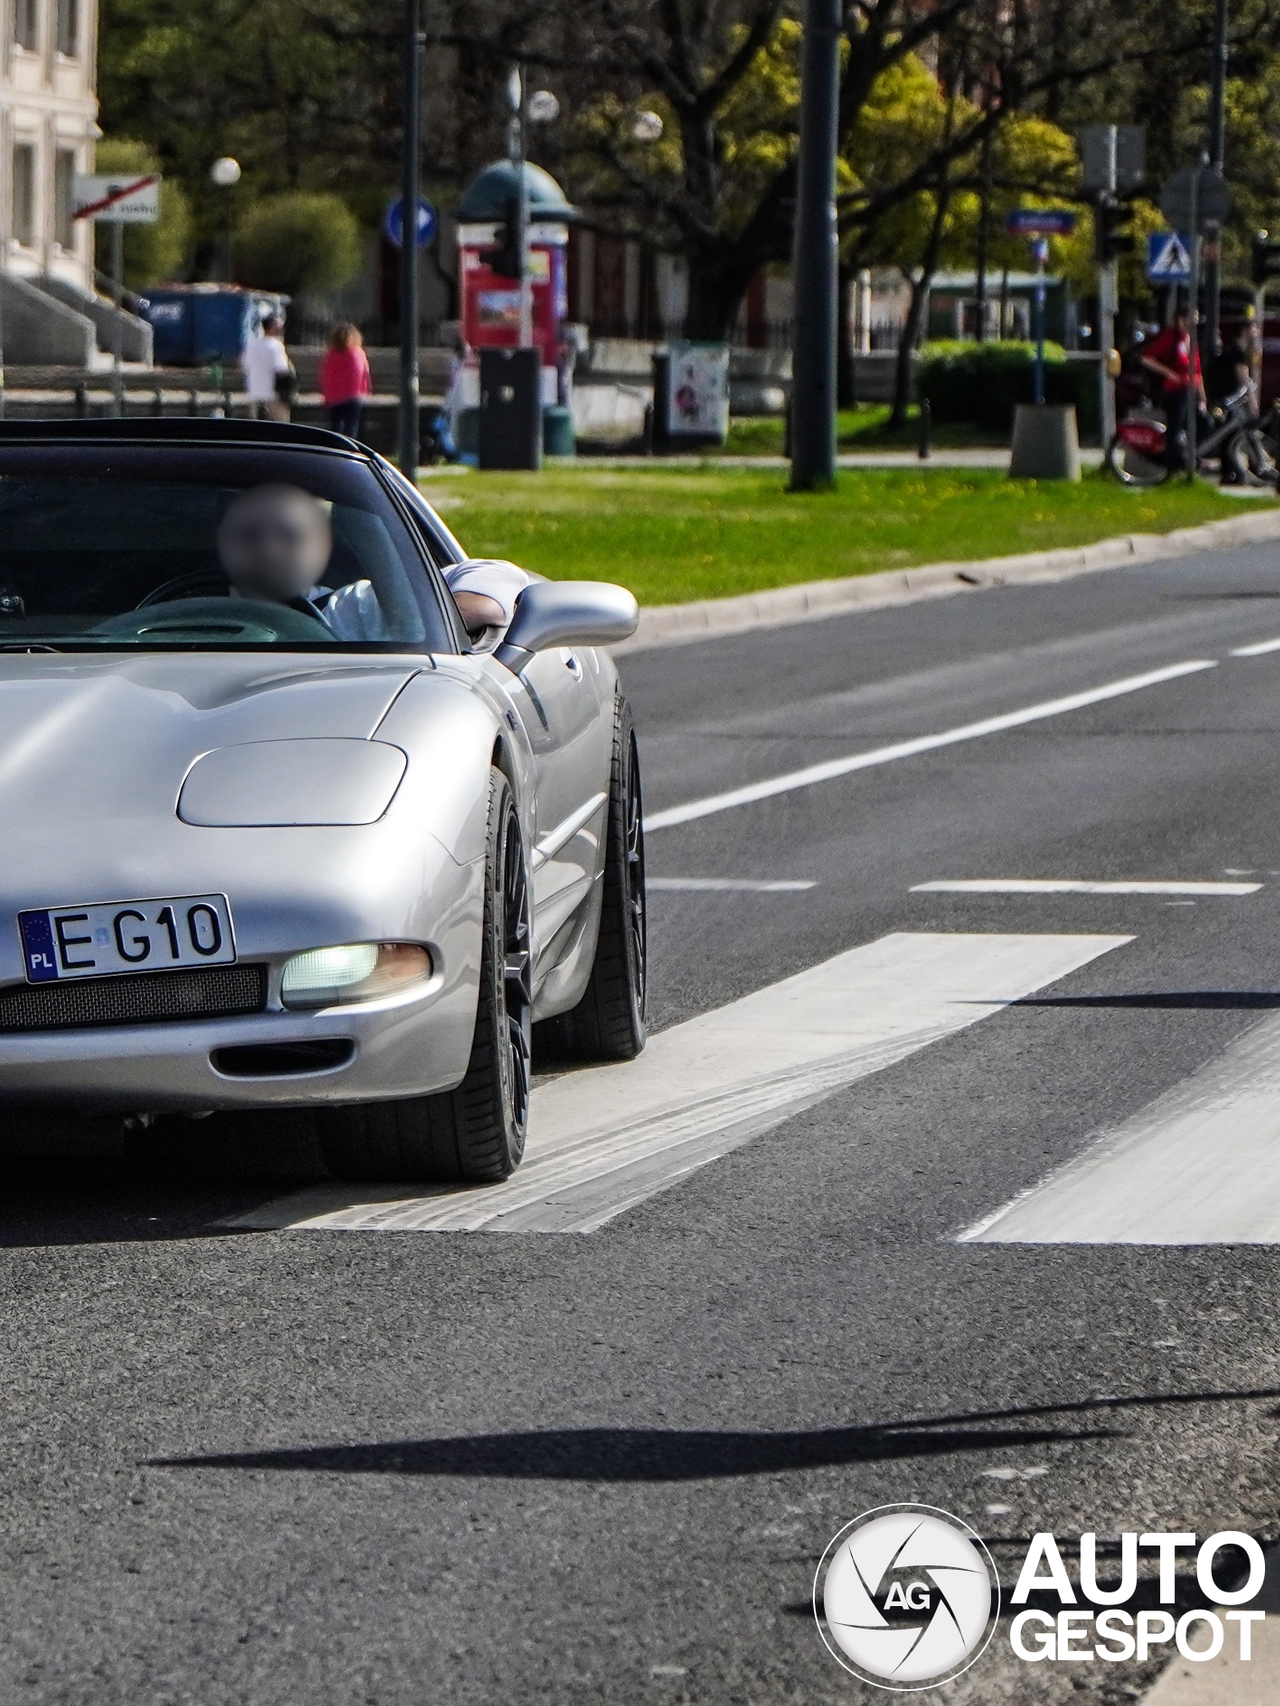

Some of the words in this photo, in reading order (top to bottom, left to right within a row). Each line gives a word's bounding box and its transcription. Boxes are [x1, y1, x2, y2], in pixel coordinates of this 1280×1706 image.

[54, 914, 96, 970] E
[114, 903, 222, 963] G10
[31, 953, 53, 969] PL
